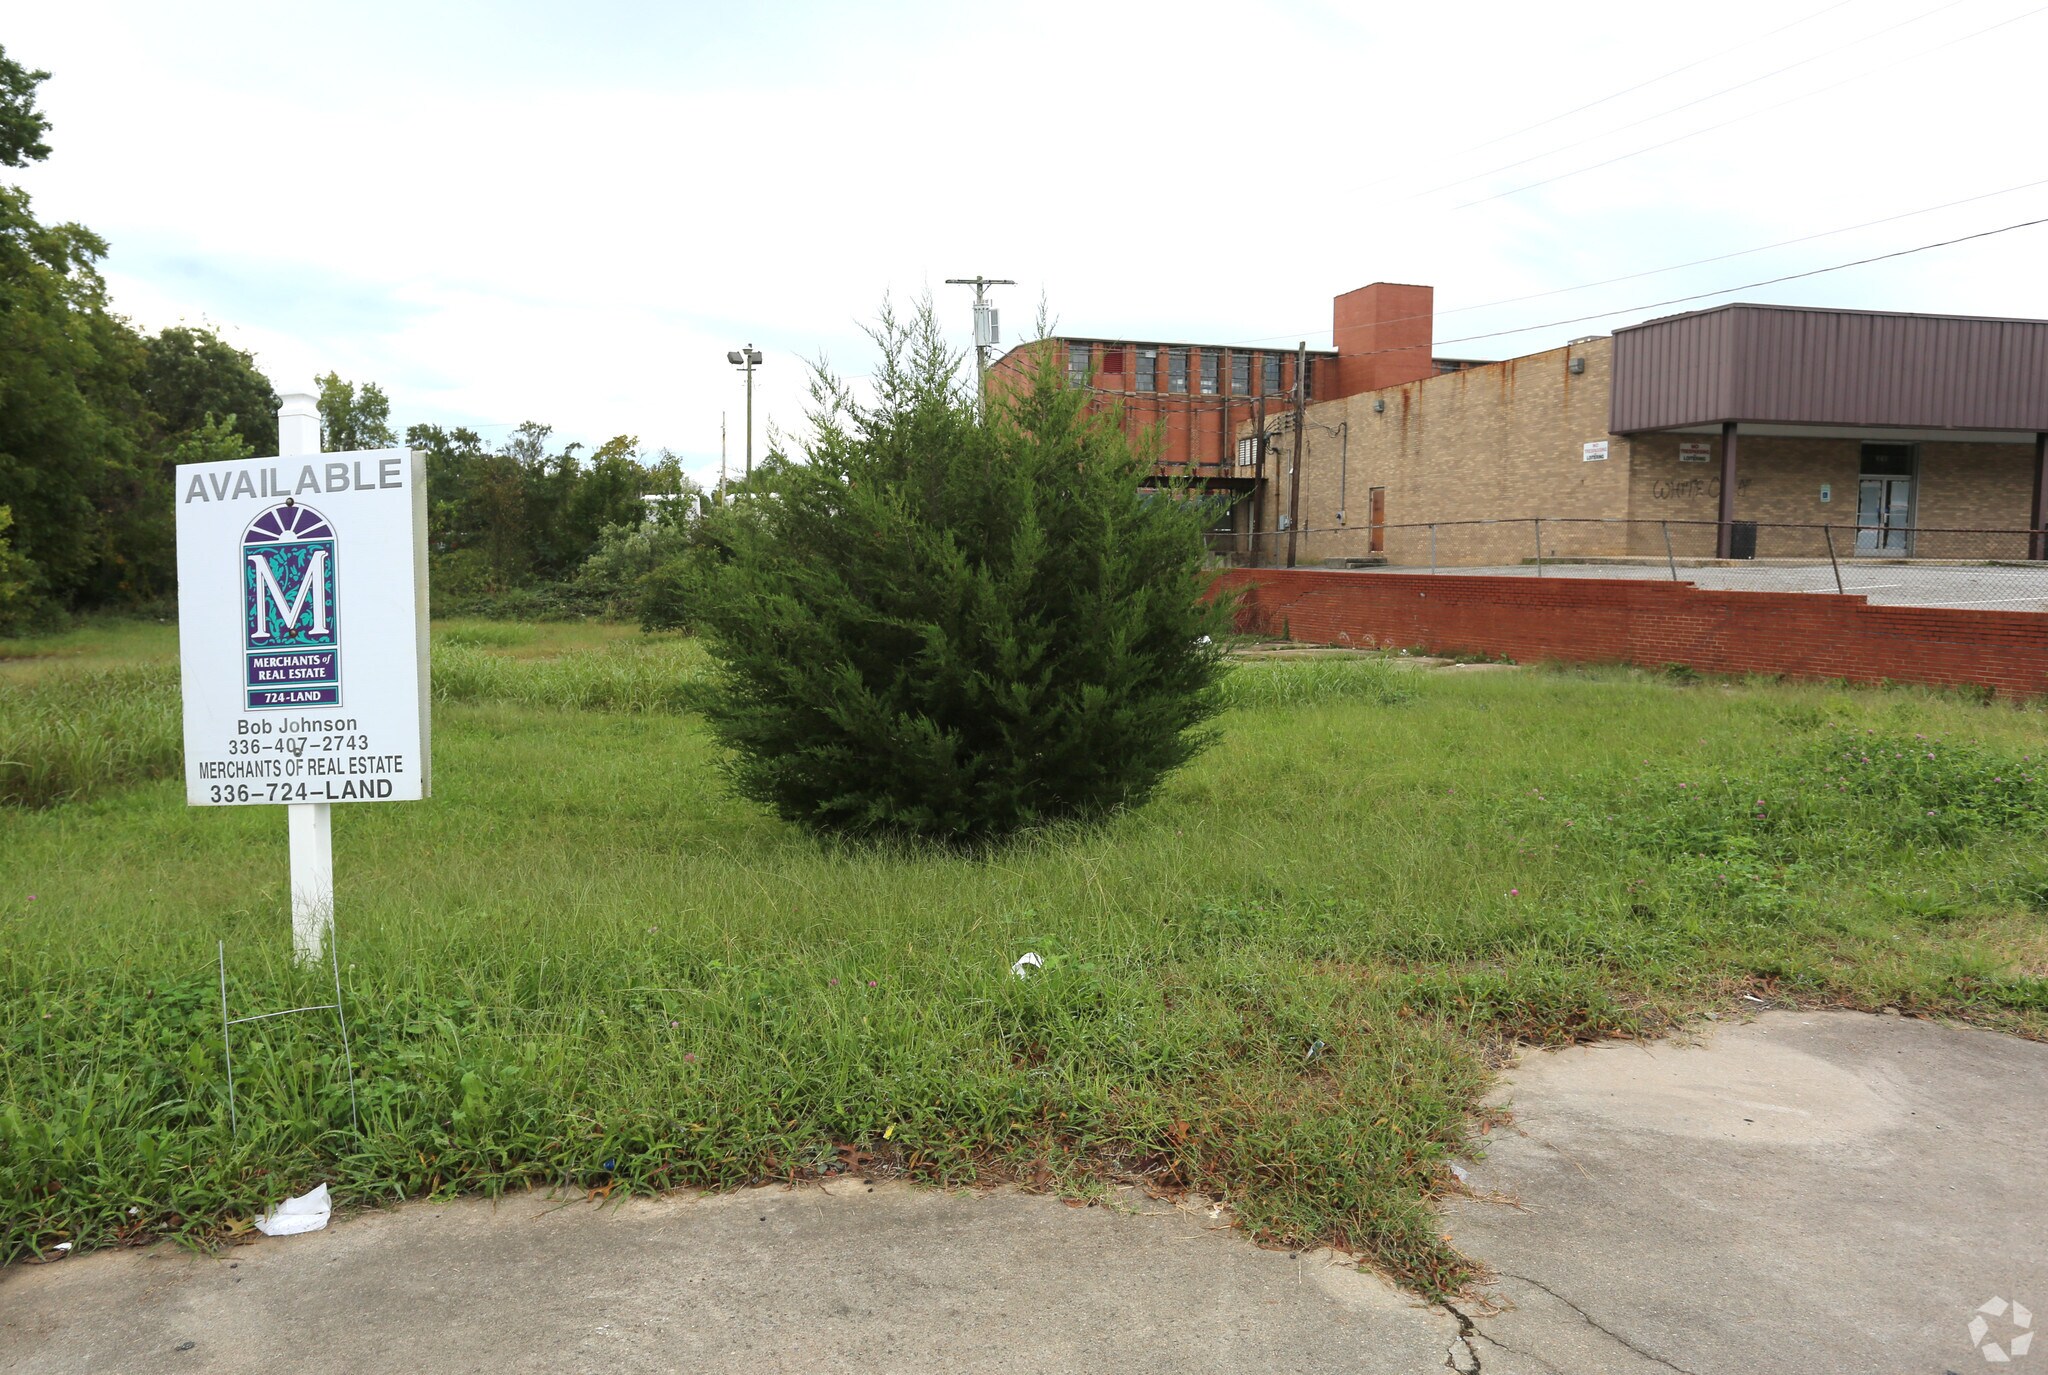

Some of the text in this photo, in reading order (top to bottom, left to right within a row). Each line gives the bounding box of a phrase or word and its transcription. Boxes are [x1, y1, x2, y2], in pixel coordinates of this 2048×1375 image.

[185, 458, 402, 503] AVAILABLE
[248, 551, 329, 638] M
[253, 654, 332, 668] MERCHANTS of
[258, 667, 326, 681] REAL ESTATE
[264, 691, 321, 703] 724-LAND
[237, 717, 357, 735] Bob Johnson
[228, 734, 369, 755] 336-407-2743
[199, 755, 403, 779] MERCHANTS OF REAL ESTATE
[210, 778, 393, 803] 336-724-LAND
